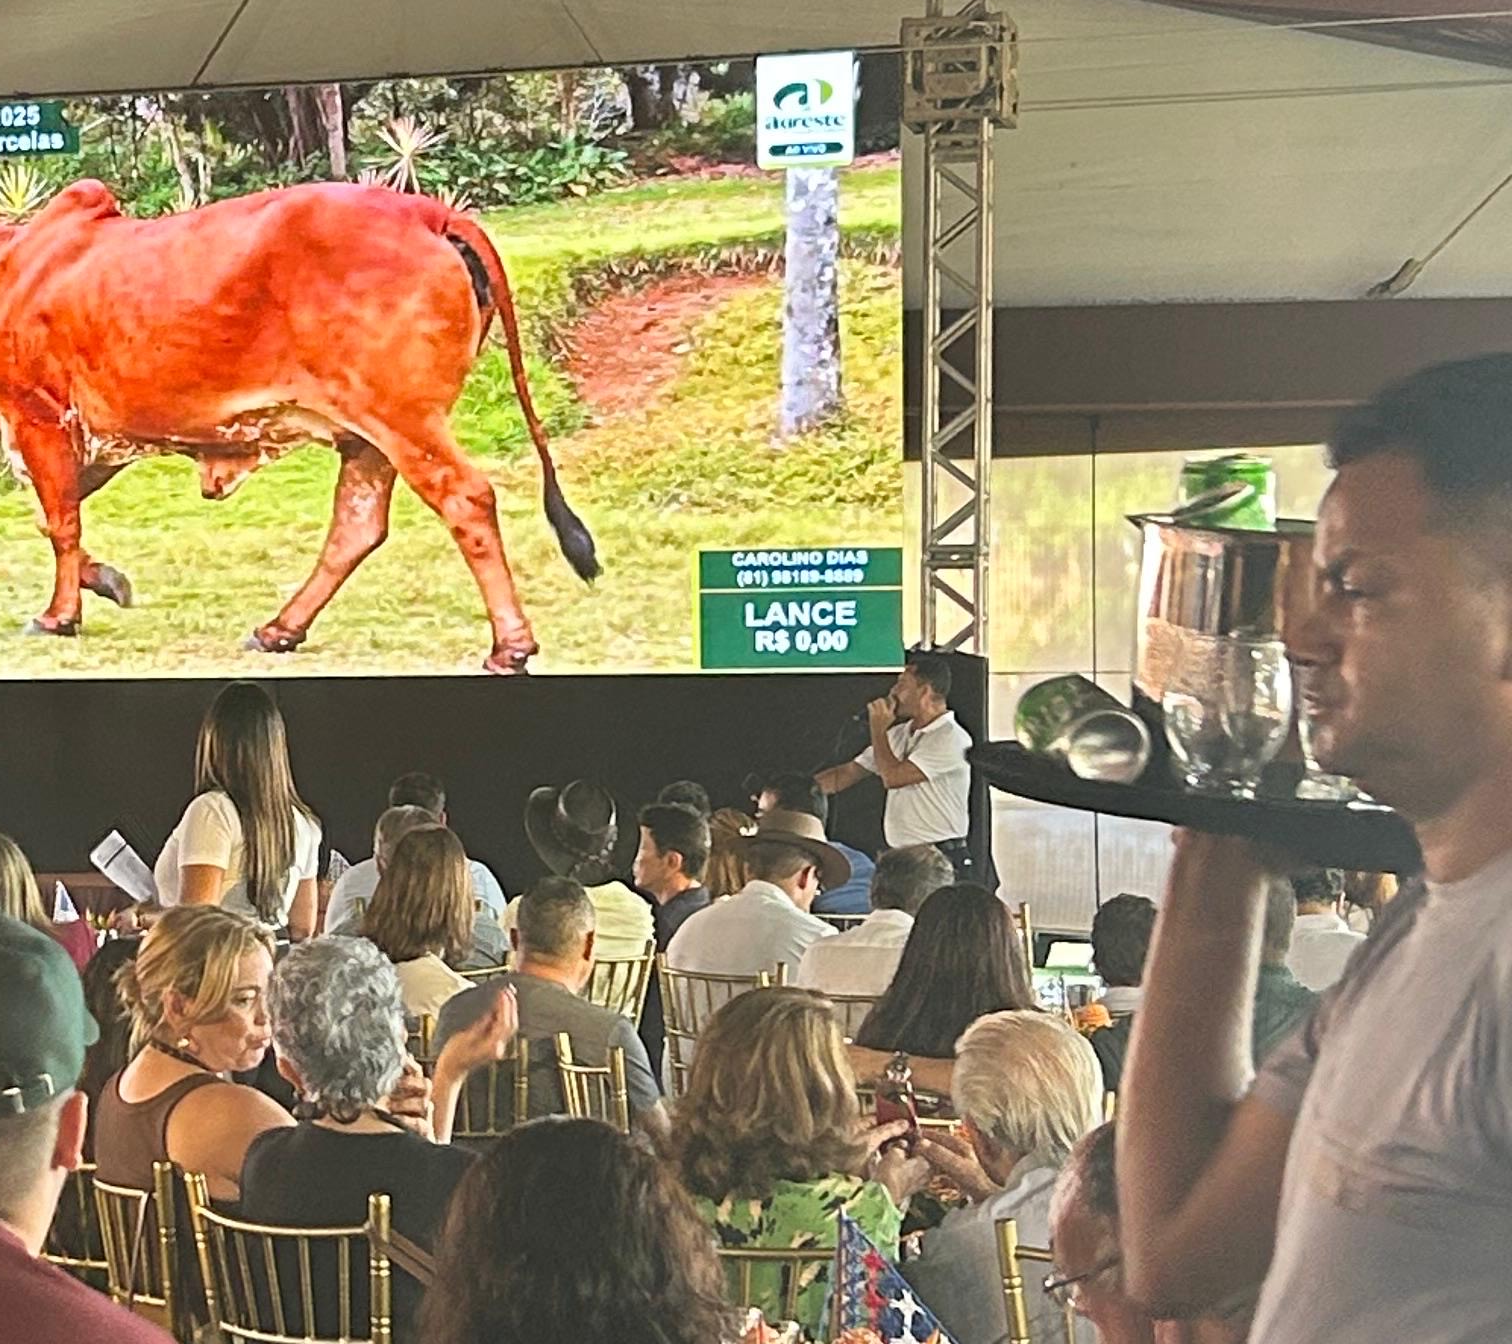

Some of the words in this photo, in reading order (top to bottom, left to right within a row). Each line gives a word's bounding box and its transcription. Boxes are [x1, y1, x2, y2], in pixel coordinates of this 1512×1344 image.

[732, 551, 825, 567] CAROLINO
[826, 550, 868, 565] DIAS
[745, 601, 857, 627] LANCE
[755, 630, 790, 654] R$
[795, 630, 848, 654] 0,00
